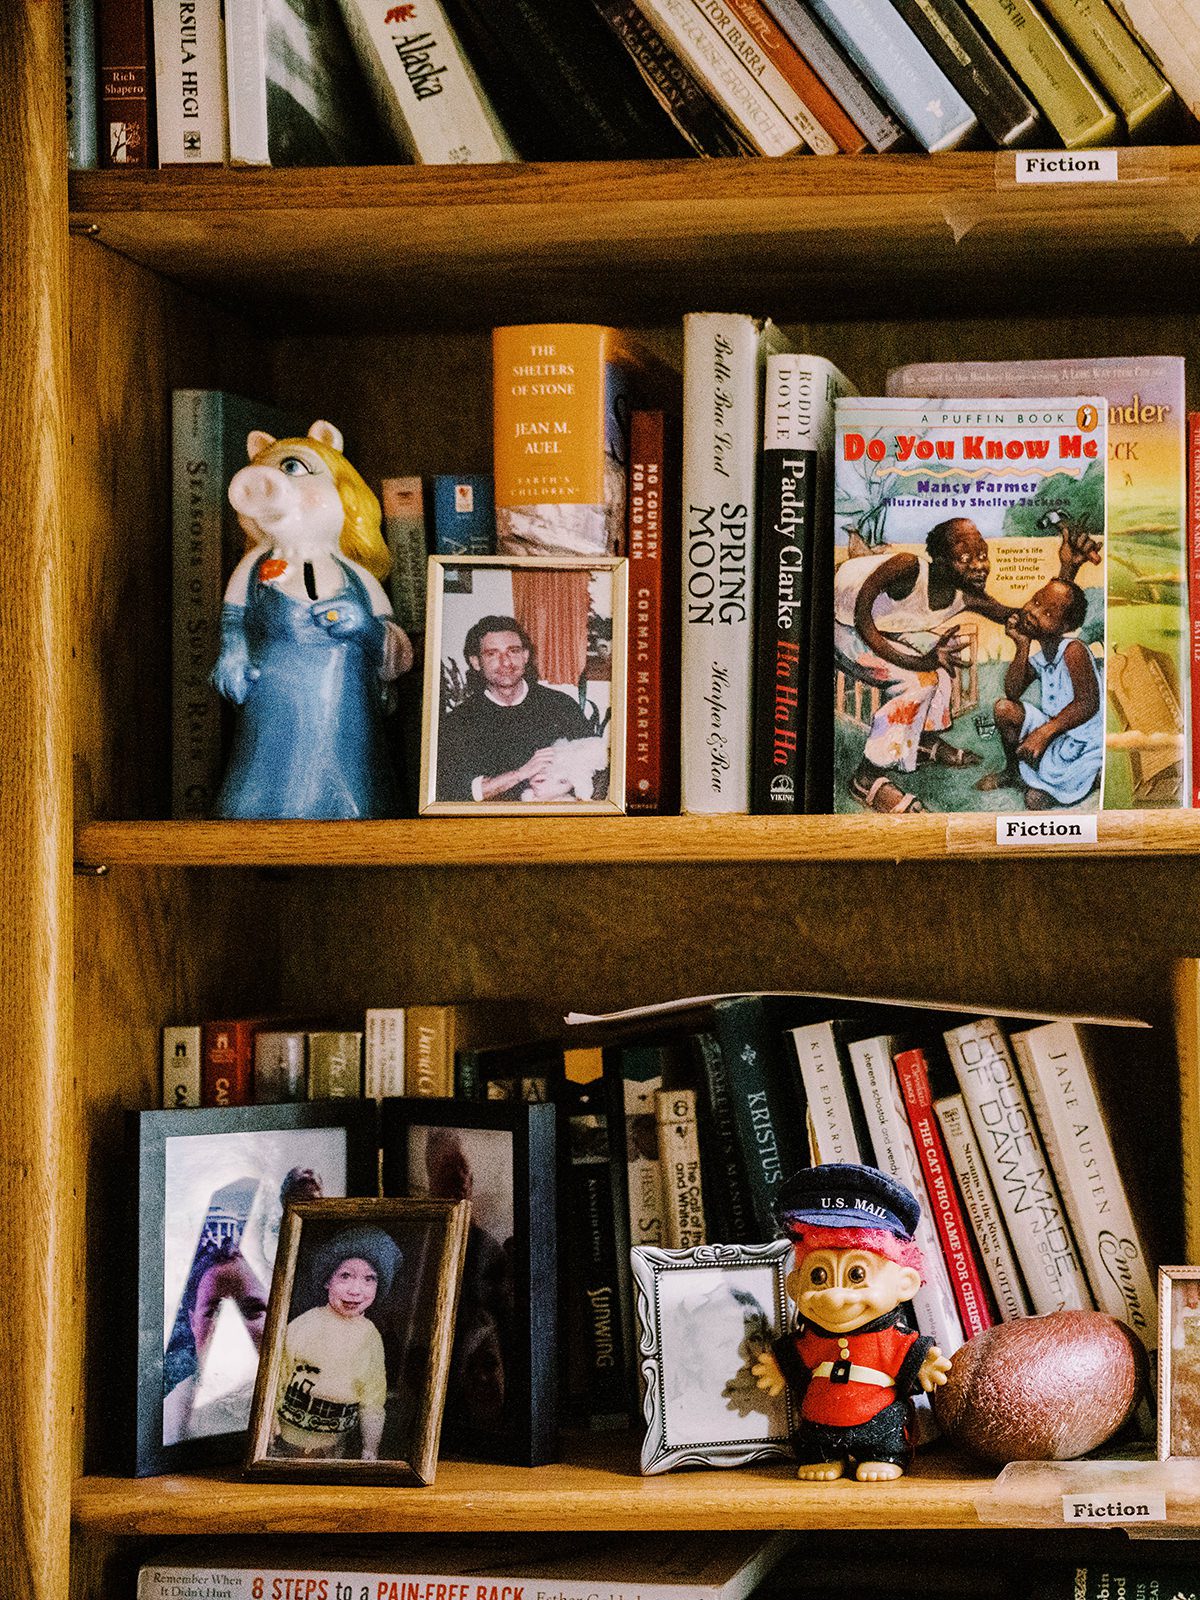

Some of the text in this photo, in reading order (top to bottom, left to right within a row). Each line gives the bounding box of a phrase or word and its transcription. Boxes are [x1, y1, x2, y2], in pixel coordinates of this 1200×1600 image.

[391, 32, 448, 102] Alaska
[725, 27, 769, 77] IBARRA
[104, 84, 144, 95] Shapero
[112, 72, 136, 82] Rich
[182, 71, 199, 119] HEGI
[1025, 157, 1101, 173] Fiction
[530, 344, 557, 356] THE
[512, 364, 575, 376] SHELTERS
[511, 383, 576, 396] OF STONE
[776, 368, 793, 441] DOYLE
[712, 334, 735, 478] Bette Bao Lord
[797, 370, 813, 441] RODDY
[921, 413, 1065, 424] A PUFFIN BOOK
[514, 422, 572, 438] JEAN M.
[524, 441, 563, 455] AUEL
[843, 433, 1099, 463] Do You Know Me
[916, 480, 1038, 495] Nancy Farmer
[632, 463, 644, 560] FOR OLD MEN
[646, 463, 658, 560] NO COUNTRY
[688, 504, 715, 627] MOON
[719, 501, 748, 627] SPRING
[996, 547, 1030, 556] Tapiwa's
[1009, 583, 1029, 591] stay!
[773, 457, 806, 766] Paddy Clarke Ha Ha Ha
[636, 588, 651, 765] CORMAC McCARTHY
[770, 793, 795, 801] VIKING
[1006, 821, 1082, 837] Fiction
[747, 1089, 784, 1185] KRISTUS
[916, 1118, 935, 1148] THE
[956, 1036, 1034, 1212] OF DAWN
[1047, 1049, 1117, 1214] JANE AUSTEN
[924, 1147, 943, 1176] CAT
[977, 1035, 1079, 1275] HOUSE MADE
[820, 1197, 889, 1220] U.S. MAIL
[931, 1175, 953, 1212] WHO
[940, 1211, 963, 1252] CAME
[951, 1251, 971, 1282] FOR
[1097, 1228, 1150, 1332] Emma
[1072, 1502, 1151, 1518] Fiction
[153, 1573, 243, 1586] Remember When
[160, 1587, 169, 1597] It
[205, 1586, 231, 1599] Hurt
[251, 1577, 370, 1600] 8 STEPS to a
[376, 1581, 525, 1600] PAIN-FREE BACK
